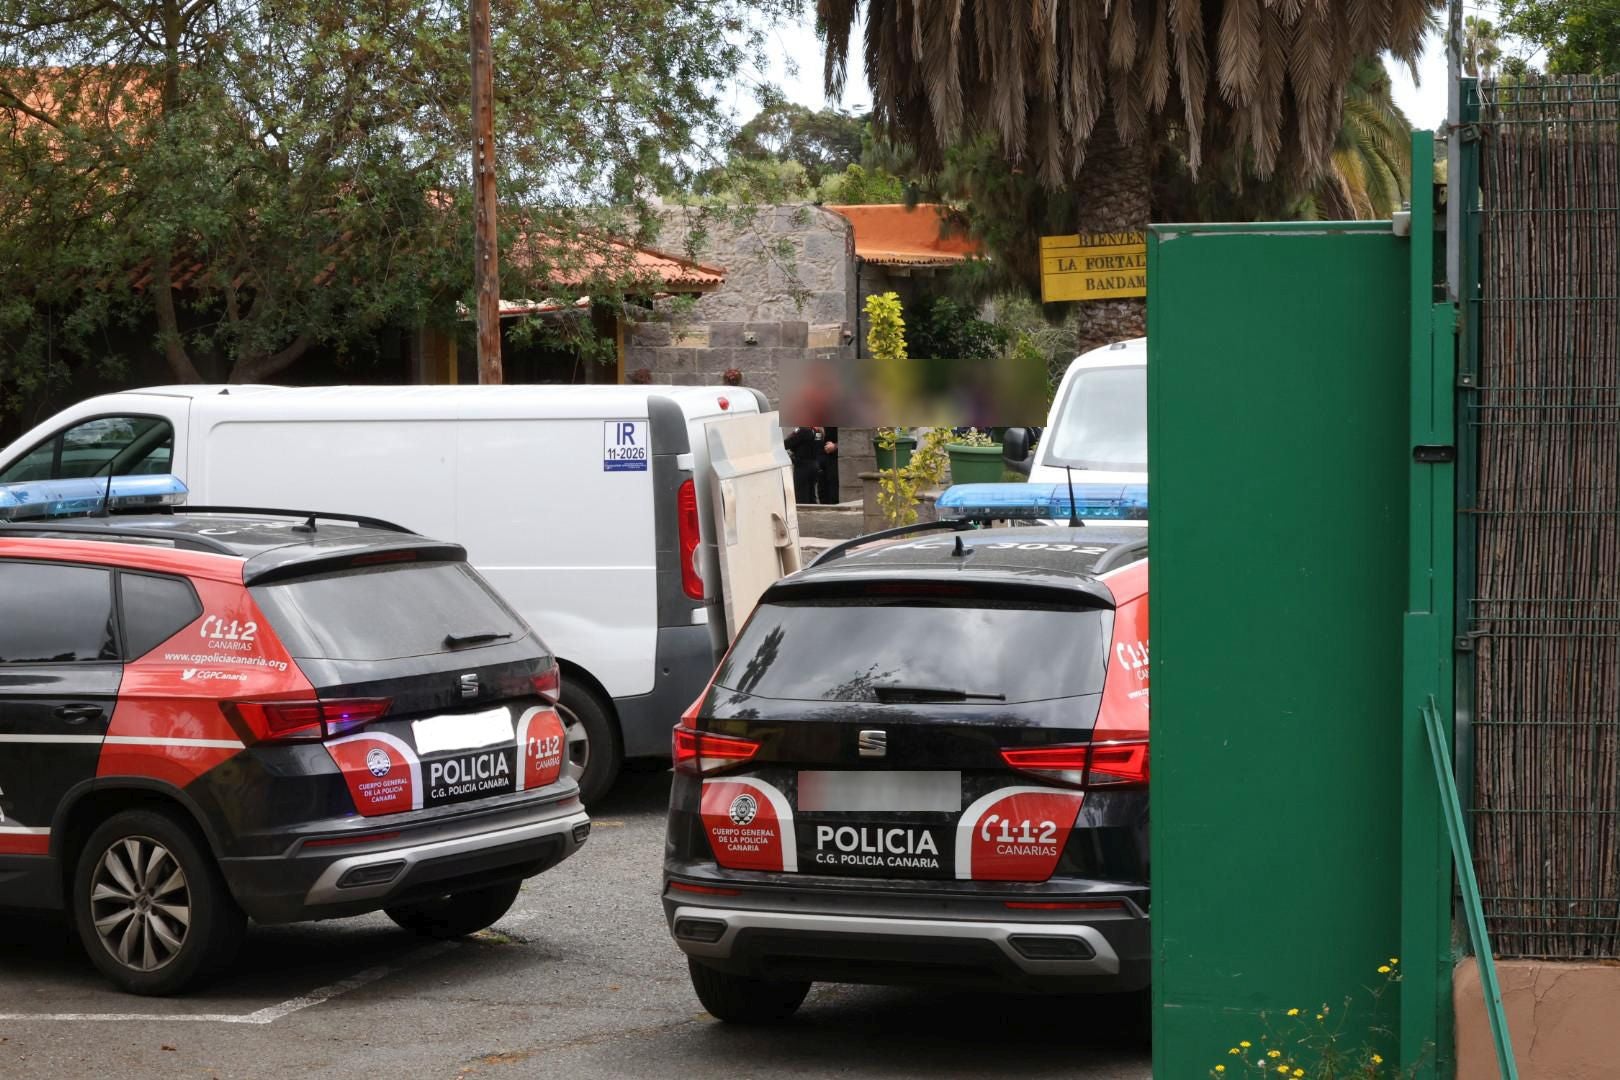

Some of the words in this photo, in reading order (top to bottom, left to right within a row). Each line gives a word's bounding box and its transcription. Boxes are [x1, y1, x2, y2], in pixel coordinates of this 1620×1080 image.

[1058, 258, 1077, 271] LA
[617, 423, 636, 445] IR
[607, 447, 645, 460] 11-2026
[208, 640, 253, 651] CANARIAS
[164, 651, 288, 672] www.cgpoliciacanaria.org
[430, 751, 510, 787] POLICIA
[358, 781, 382, 790] CUERPO
[382, 777, 408, 787] GENERAL
[431, 788, 447, 799] C.G.
[448, 783, 477, 796] POLICIA
[478, 777, 510, 791] CANARIA
[364, 789, 373, 798] DE
[373, 788, 381, 796] LA
[371, 793, 397, 803] CANARIA
[712, 827, 740, 836] CUERPO
[741, 828, 775, 837] GENERAL
[718, 835, 728, 843] DE
[729, 836, 738, 844] LA
[816, 825, 939, 855] POLICIA
[727, 843, 760, 852] CANARIA
[996, 844, 1057, 856] CANARIAS
[815, 853, 838, 864] C.G.
[840, 854, 885, 866] POLICIA
[886, 856, 940, 868] CANARIA
